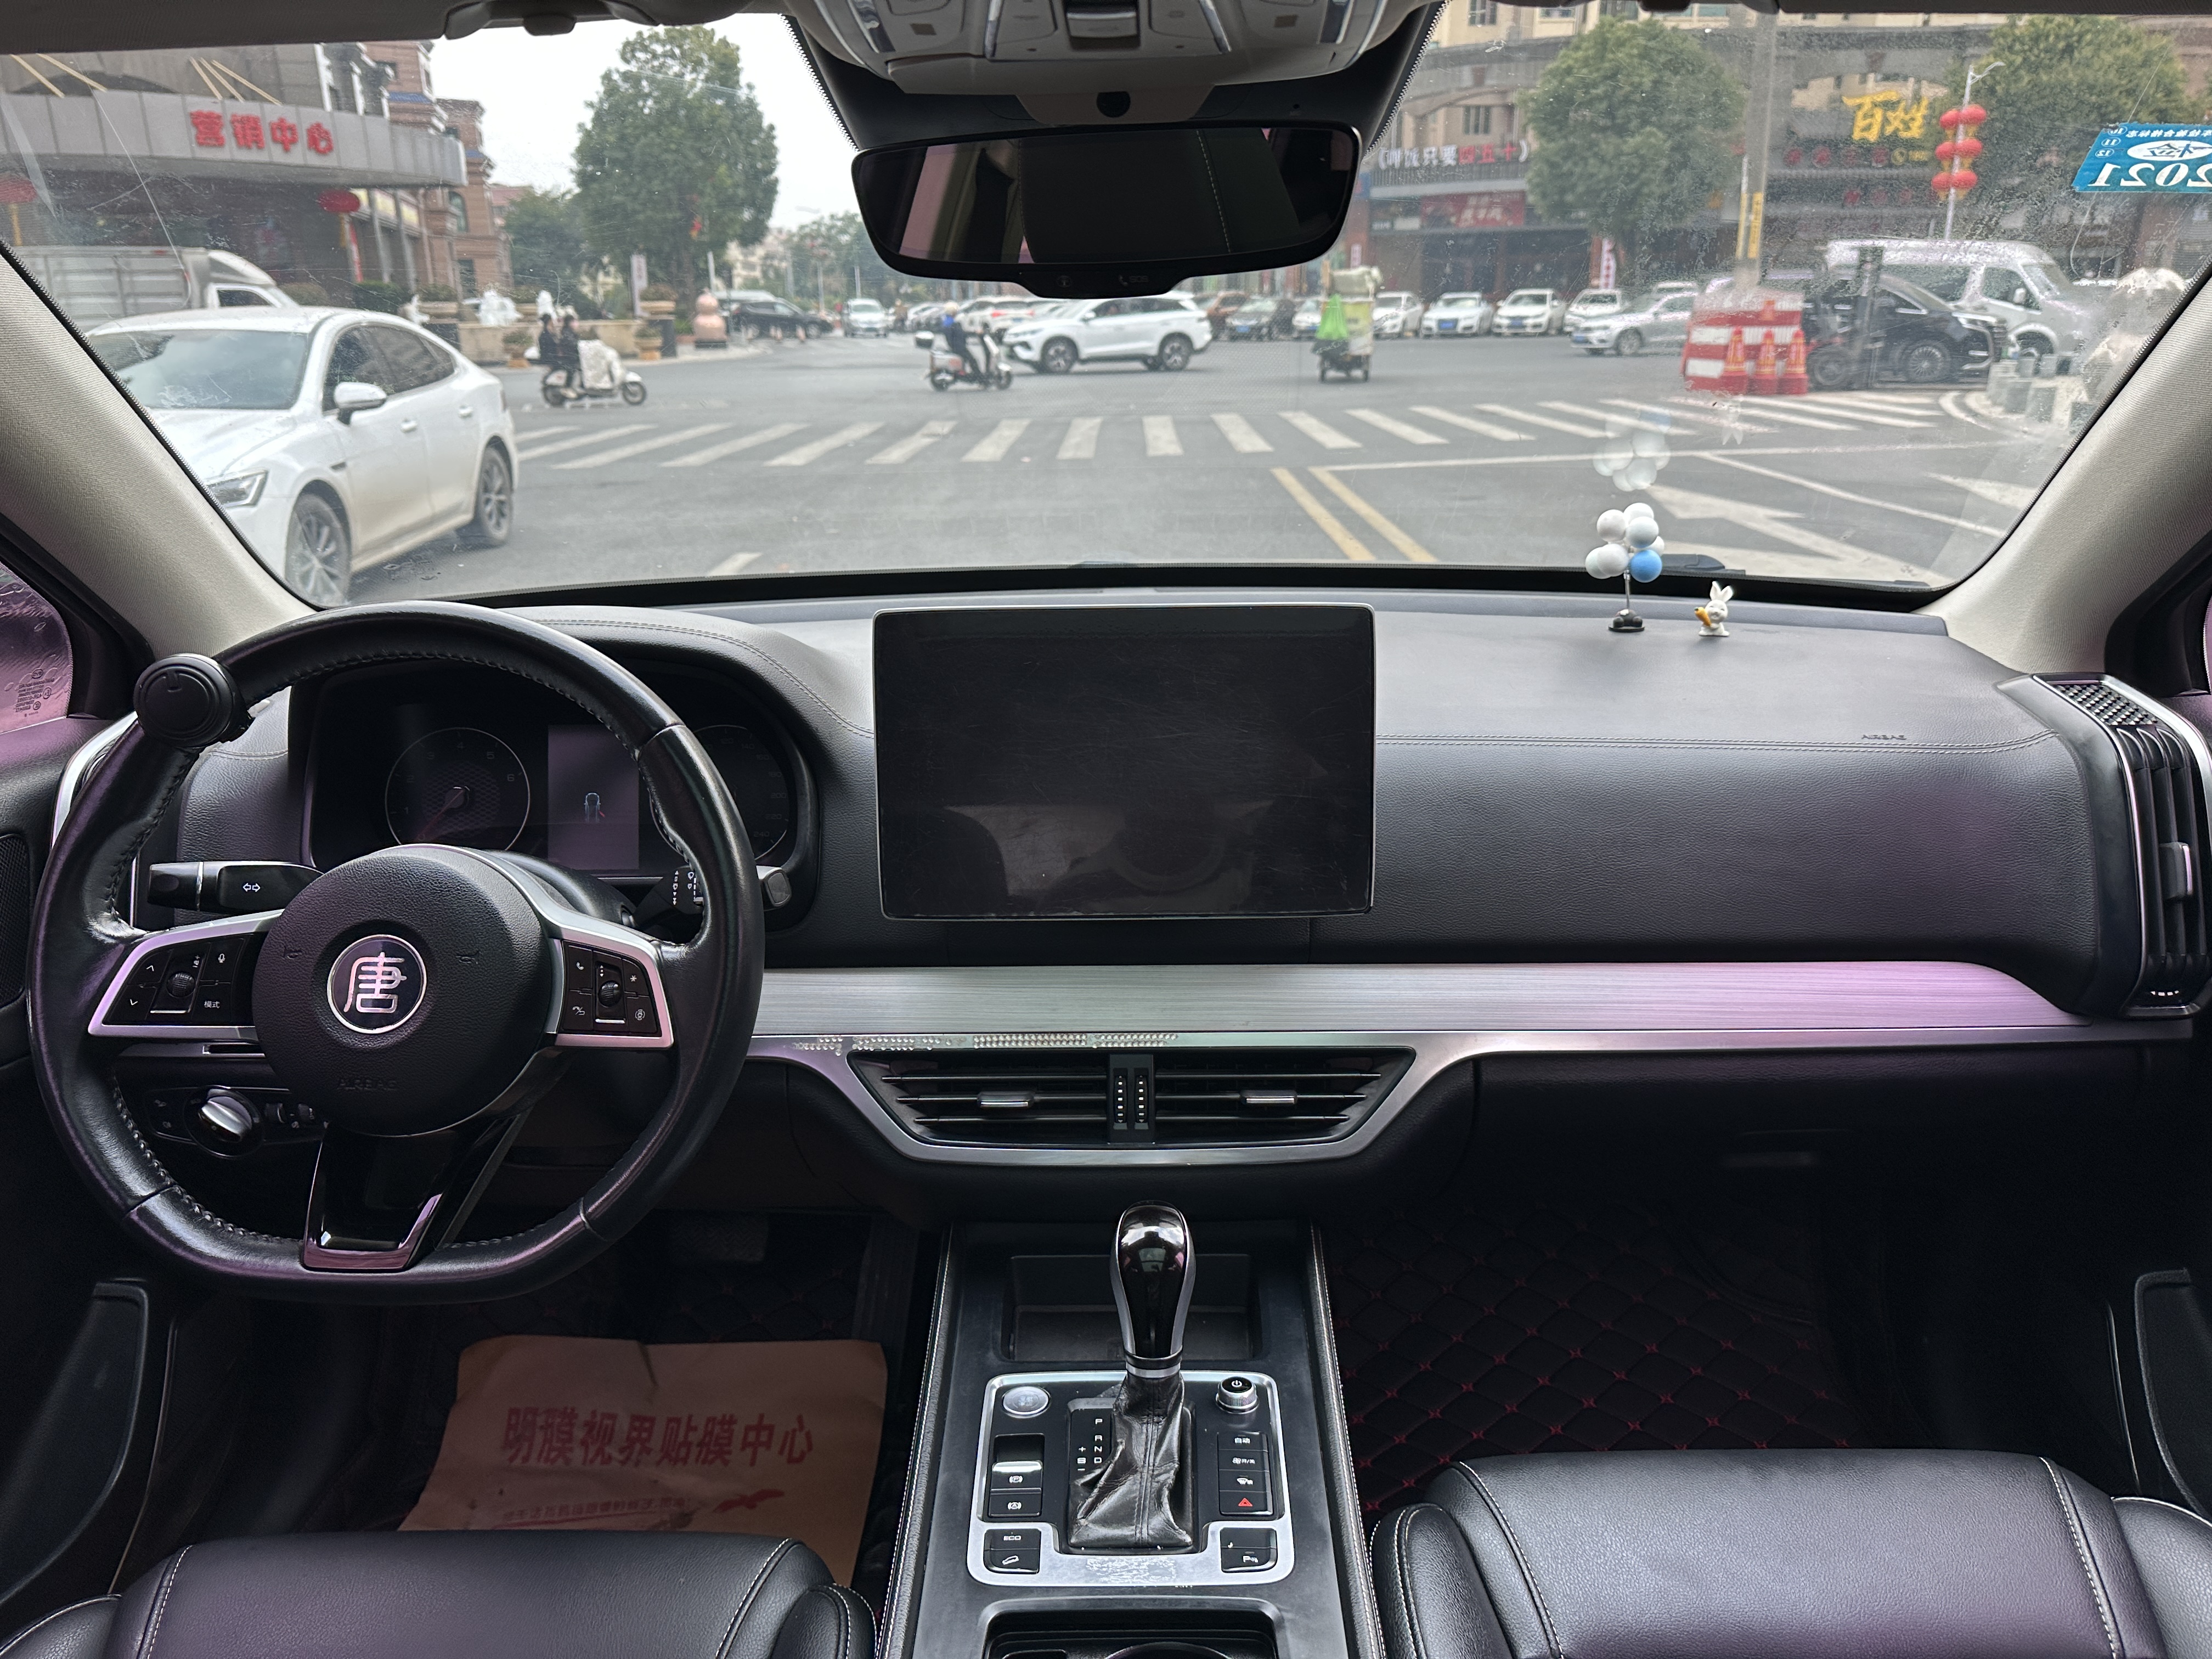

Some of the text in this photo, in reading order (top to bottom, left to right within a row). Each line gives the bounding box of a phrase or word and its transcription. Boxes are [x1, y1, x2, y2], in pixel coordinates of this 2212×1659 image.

[190, 110, 334, 156] 营销中心
[204, 1000, 221, 1009] 模式
[343, 951, 407, 1014] 唐
